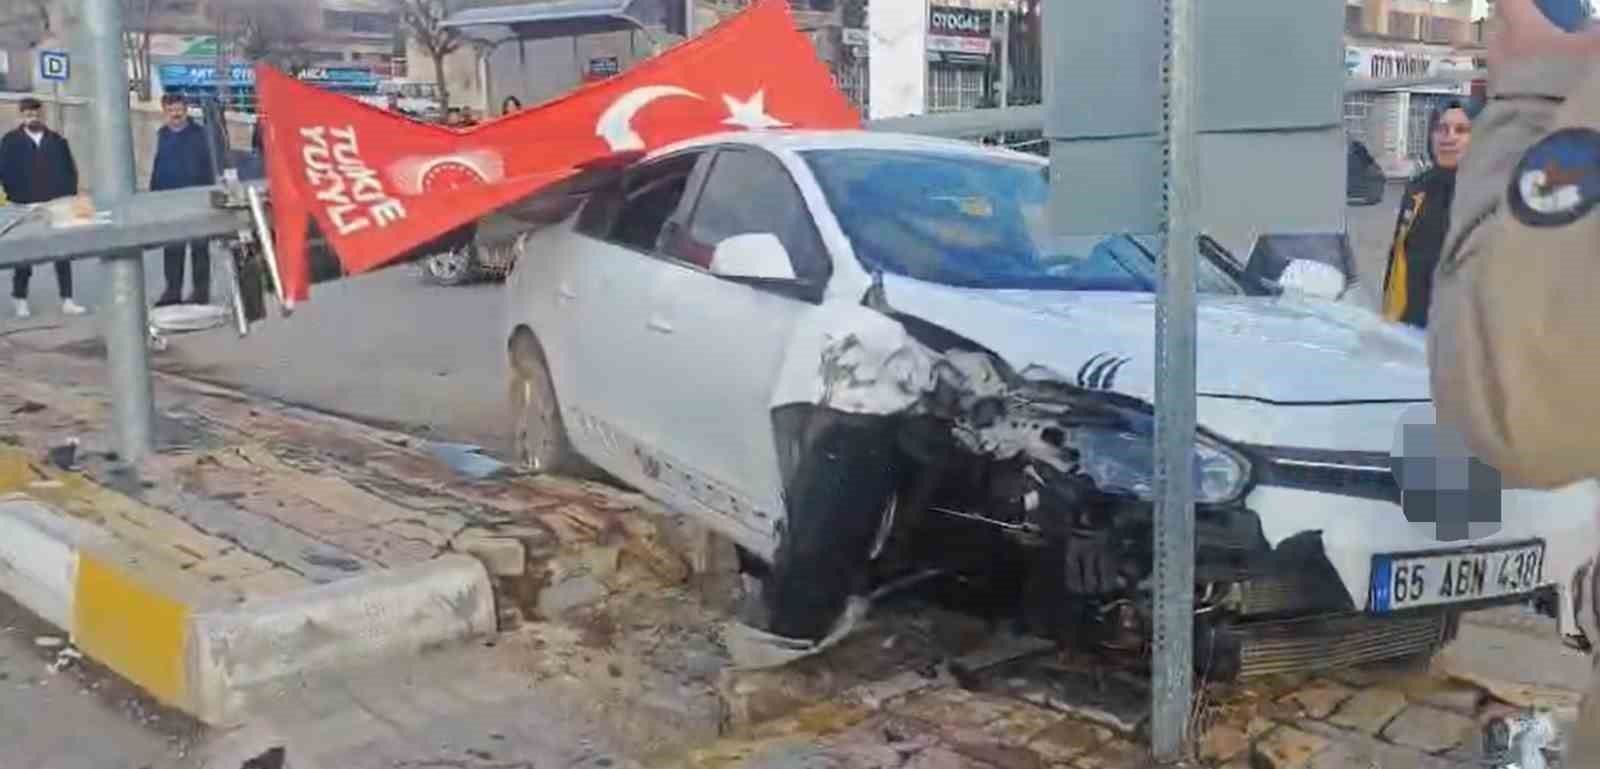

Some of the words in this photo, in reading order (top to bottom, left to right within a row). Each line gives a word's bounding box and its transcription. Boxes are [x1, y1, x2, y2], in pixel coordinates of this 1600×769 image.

[932, 12, 980, 31] OTOGAZ
[48, 58, 62, 74] D
[1394, 564, 1425, 602] 65
[1439, 557, 1487, 597] ABN
